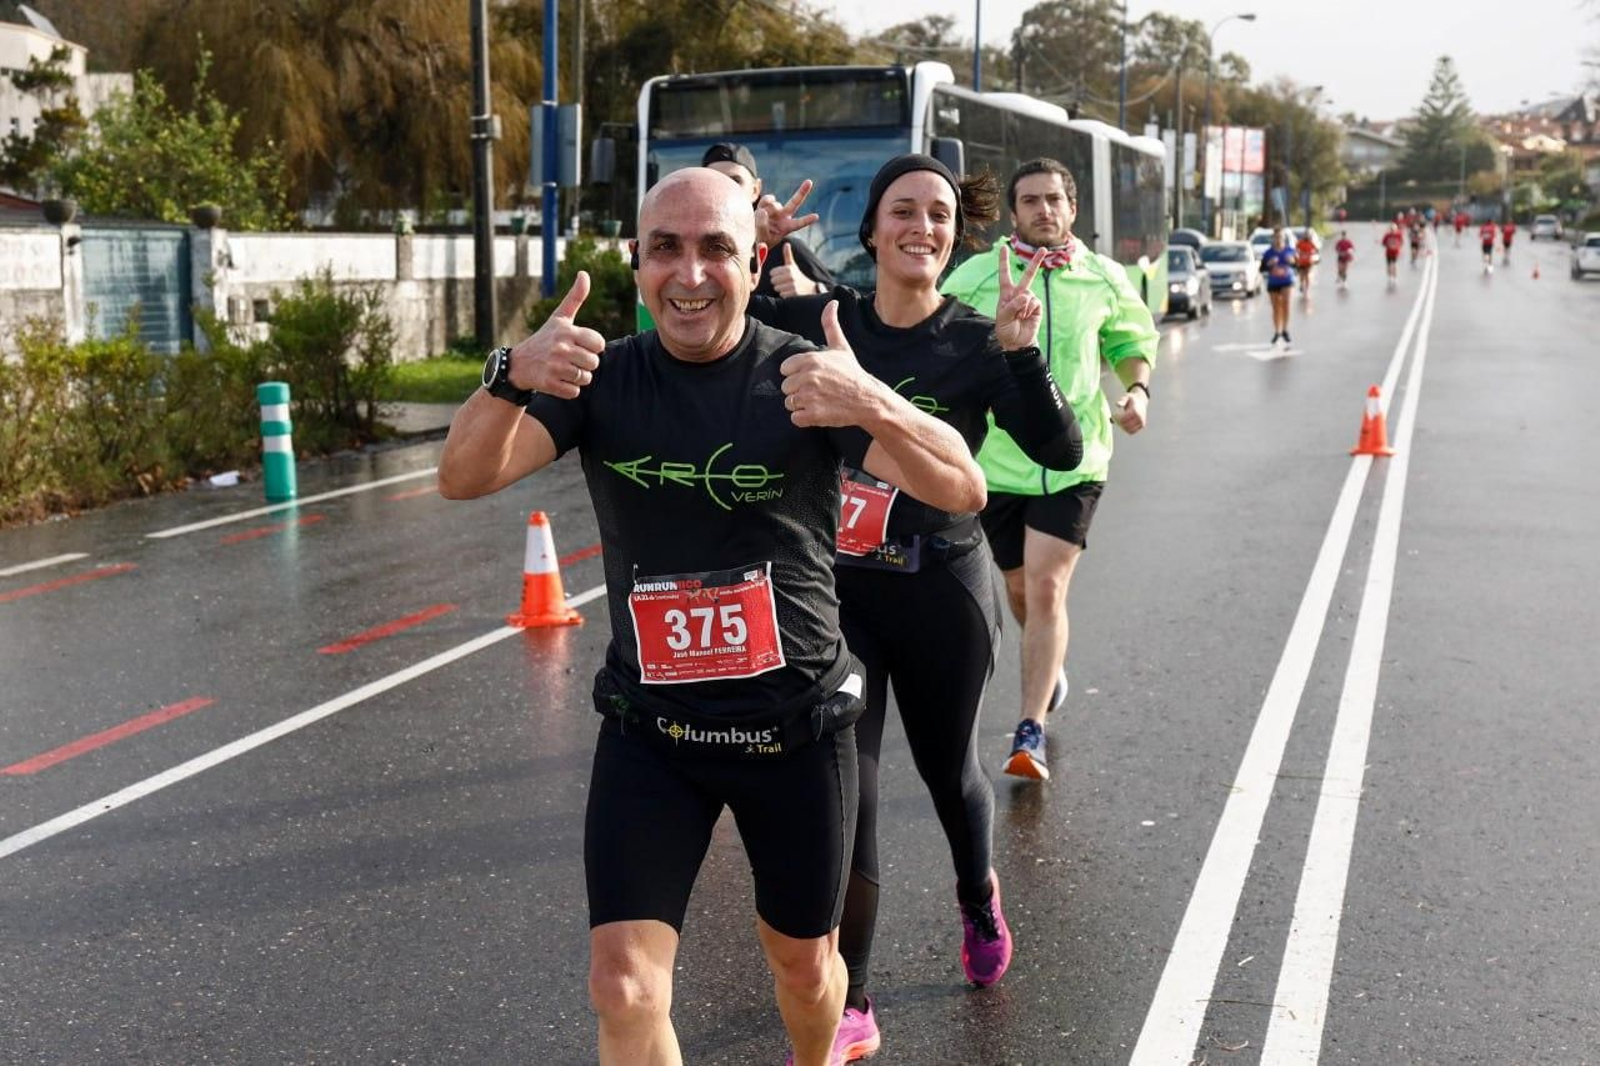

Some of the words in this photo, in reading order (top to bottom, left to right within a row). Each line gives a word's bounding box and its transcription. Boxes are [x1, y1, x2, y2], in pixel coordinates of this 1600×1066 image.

[664, 603, 748, 651] 375
[656, 716, 773, 747] Columbus
[757, 742, 782, 754] Trail
